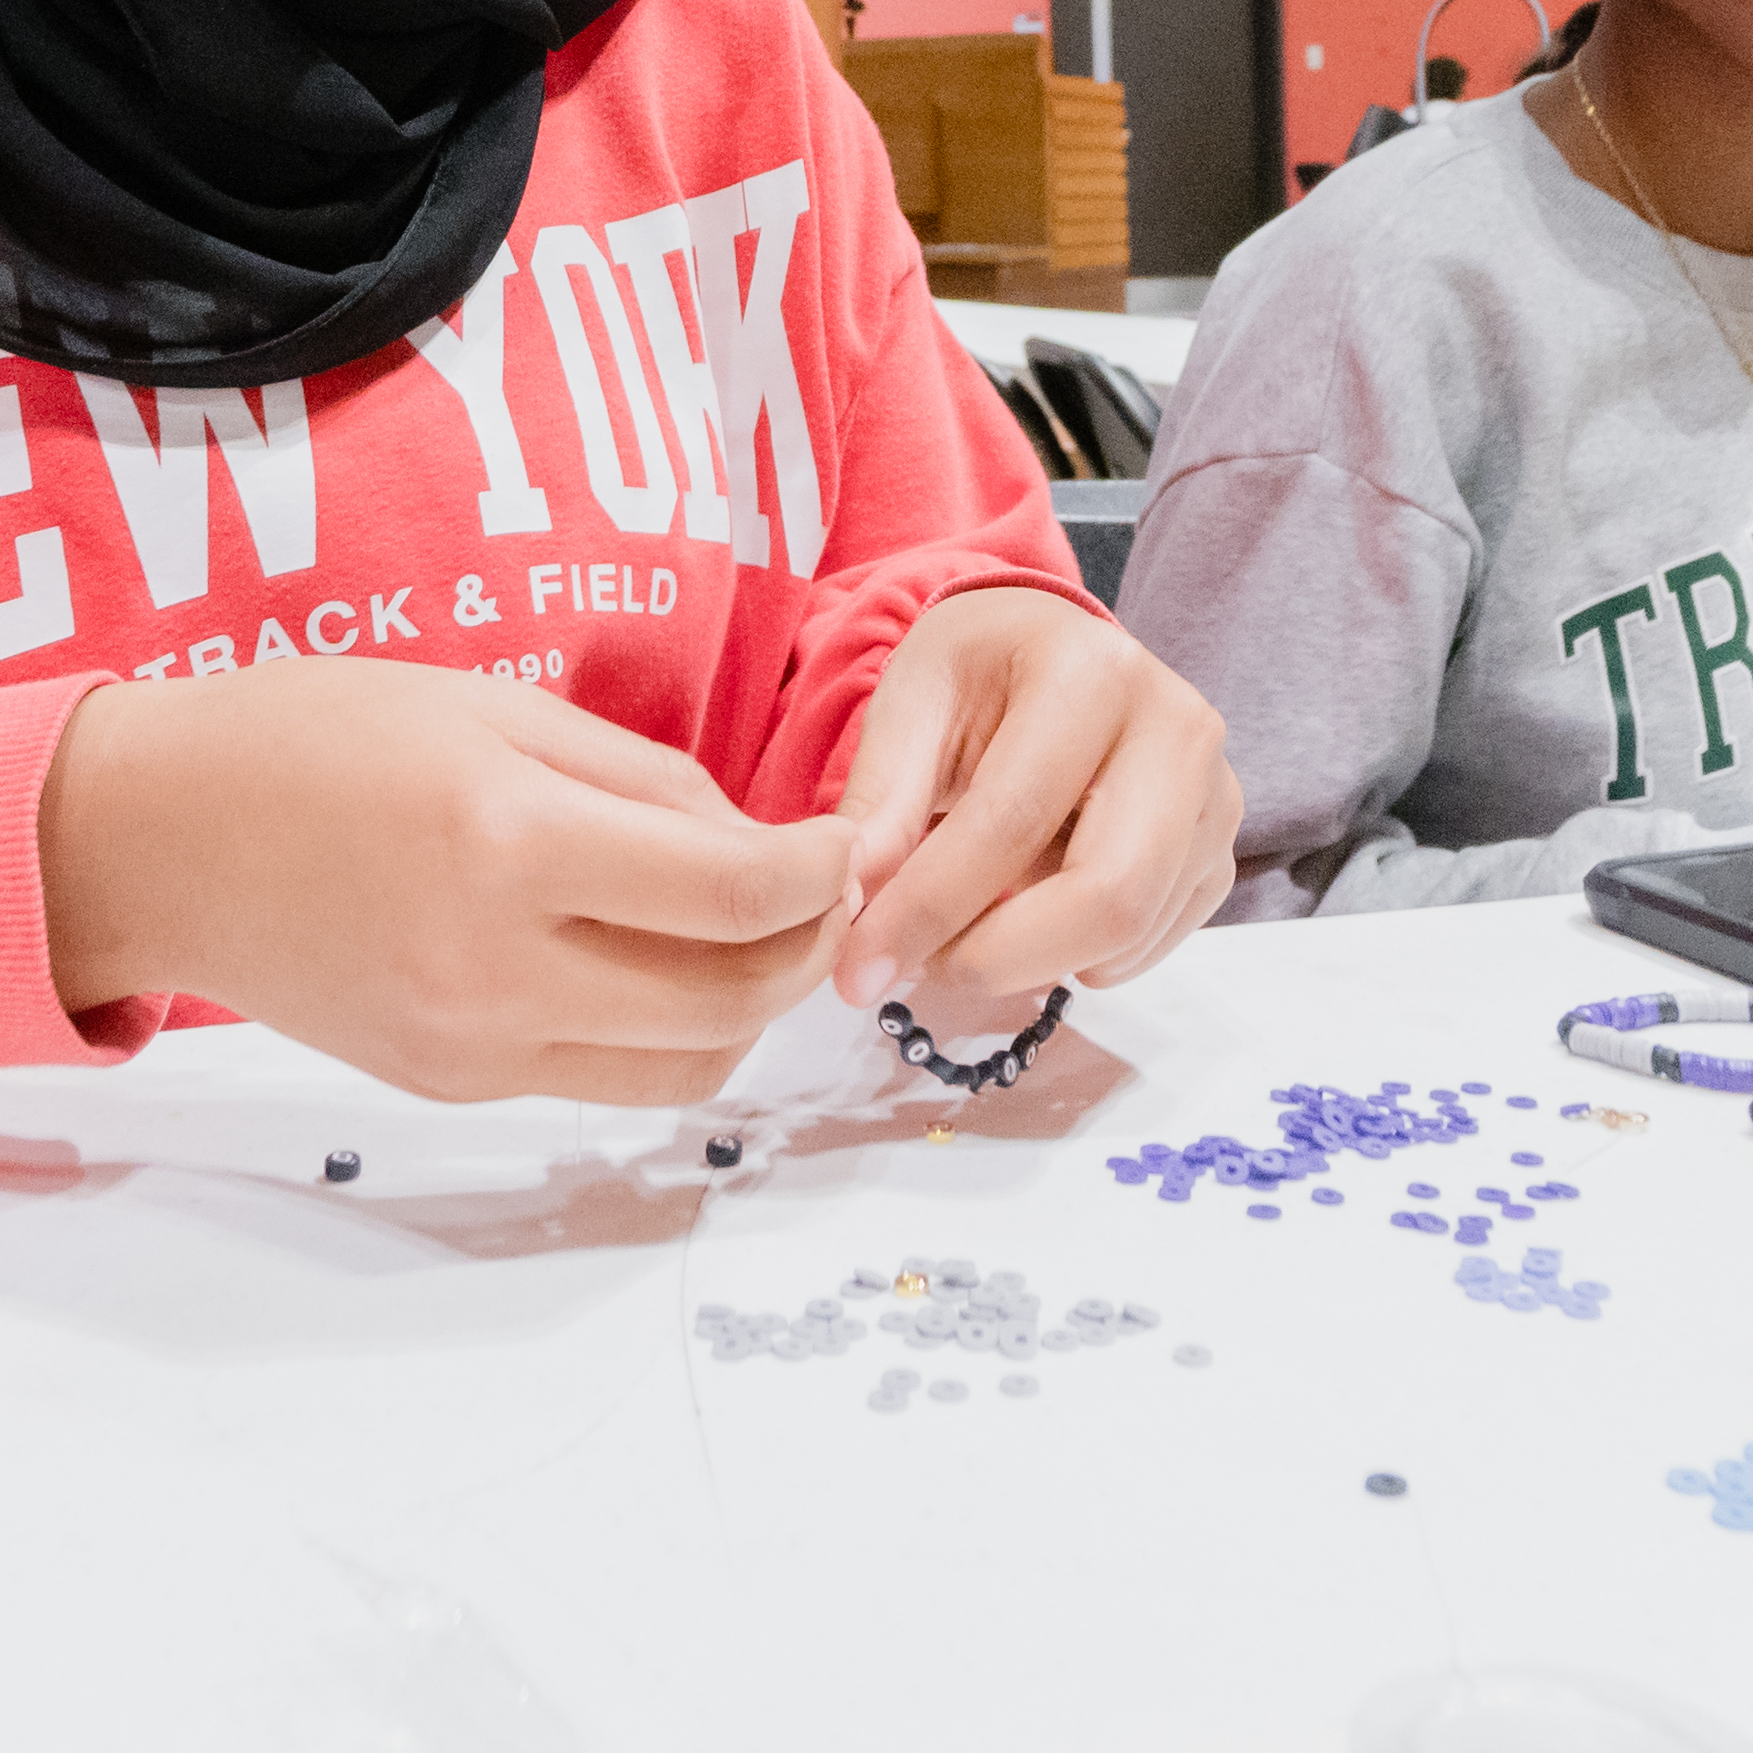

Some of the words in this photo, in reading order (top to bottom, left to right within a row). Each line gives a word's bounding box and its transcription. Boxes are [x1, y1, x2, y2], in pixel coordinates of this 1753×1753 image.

[405, 158, 827, 579] YORK
[452, 573, 503, 628] &
[528, 562, 679, 617] FIELD
